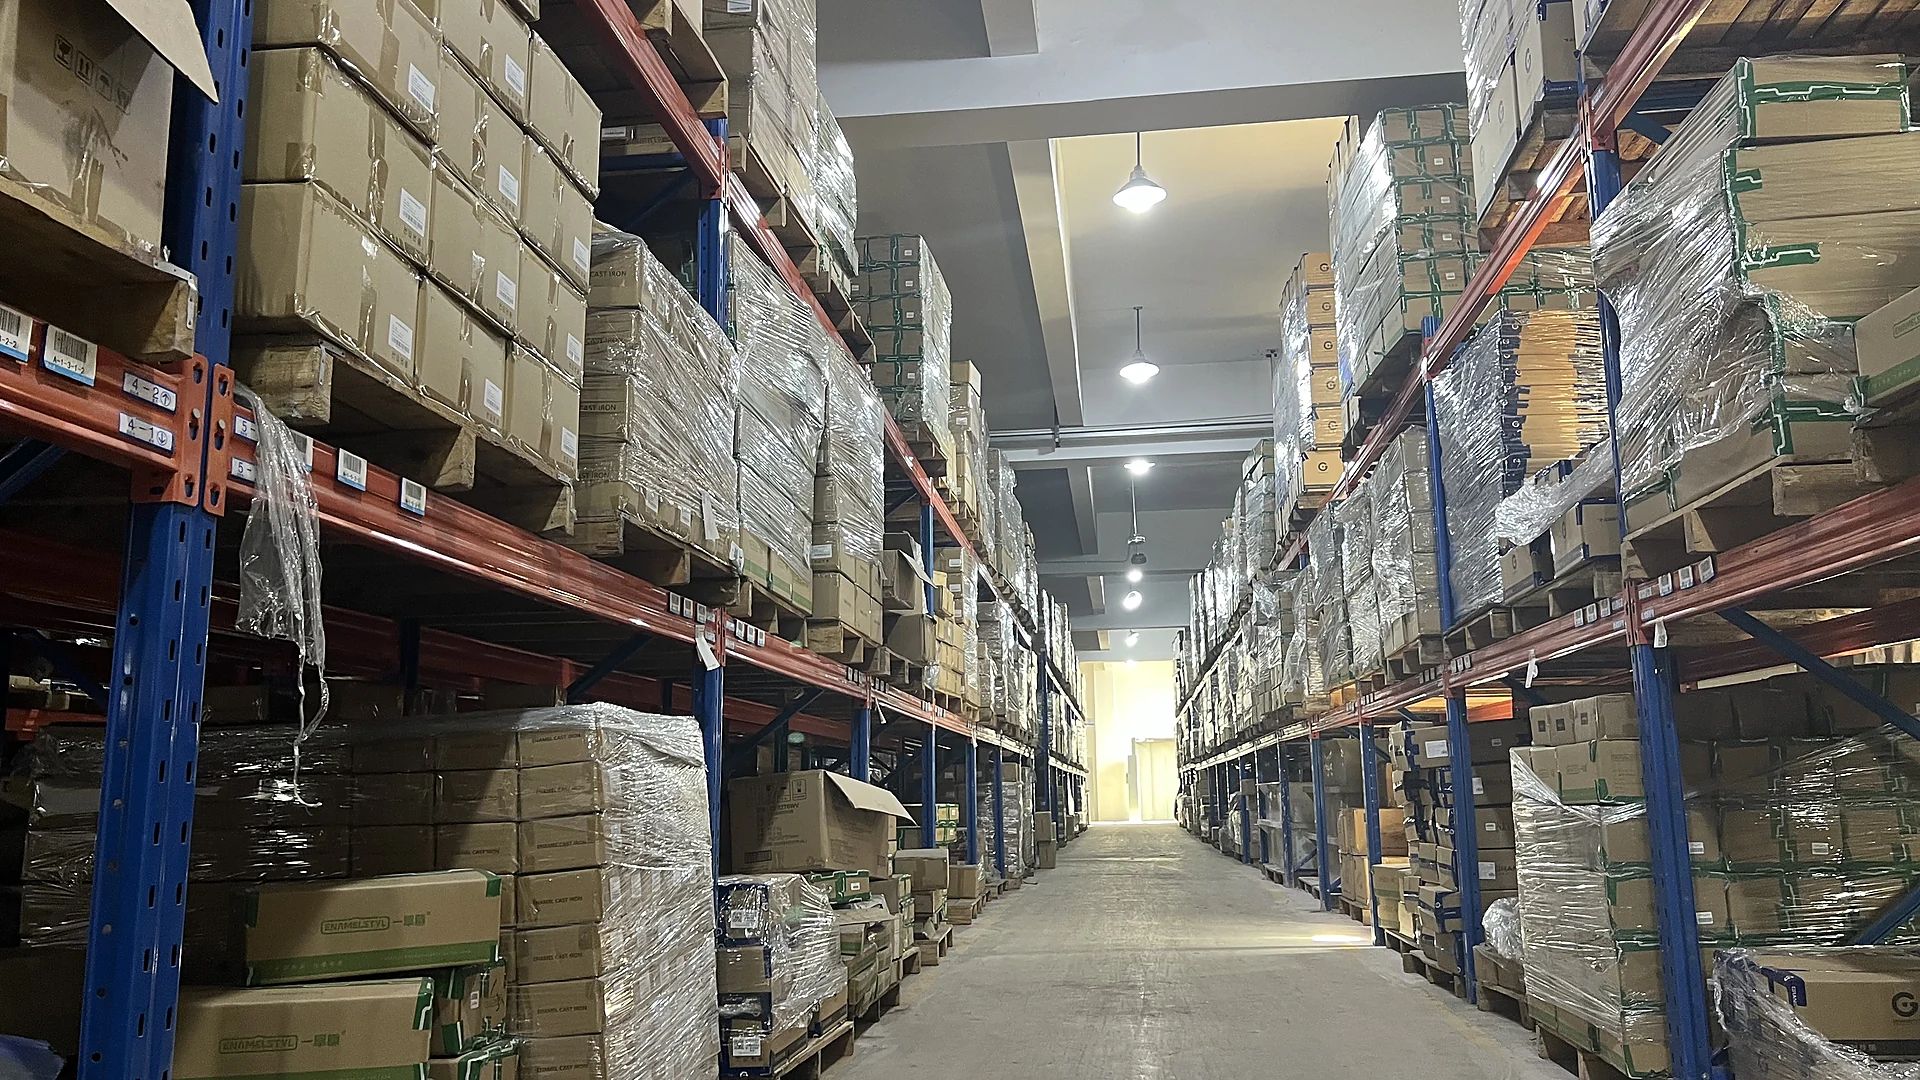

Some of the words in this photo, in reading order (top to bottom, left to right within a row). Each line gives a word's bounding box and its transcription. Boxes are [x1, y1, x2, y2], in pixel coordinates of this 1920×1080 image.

[53, 356, 85, 374] A-1-3-1-2
[1318, 462, 1328, 471] G
[1892, 992, 1918, 1017] G
